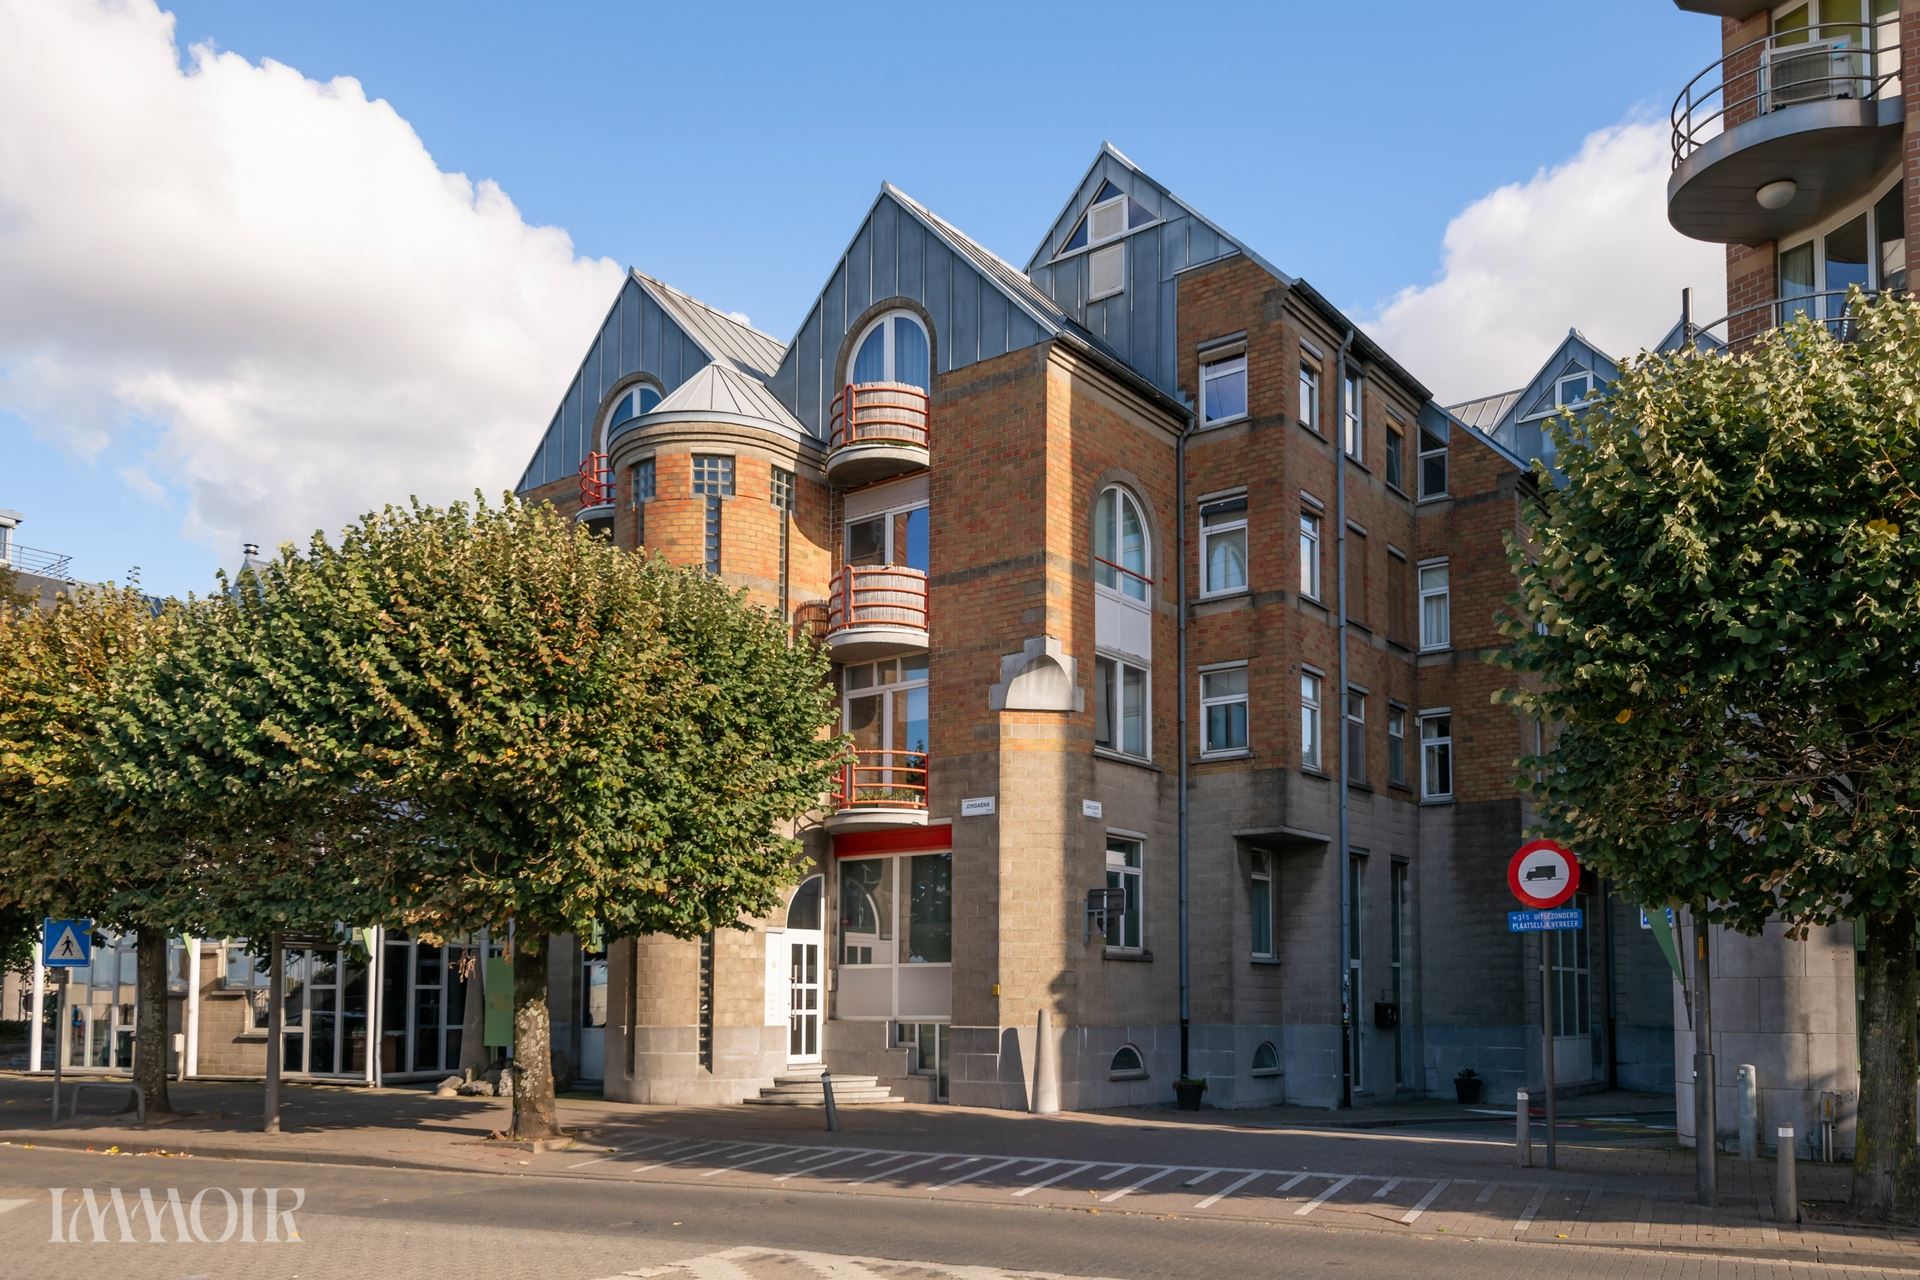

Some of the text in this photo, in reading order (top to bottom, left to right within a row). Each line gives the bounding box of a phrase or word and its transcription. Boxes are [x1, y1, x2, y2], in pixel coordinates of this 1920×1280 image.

[965, 801, 990, 809] JORDAENS
[1533, 911, 1579, 920] UITGEZONDERD
[1512, 919, 1579, 930] PLAATSELIJK VERKEER
